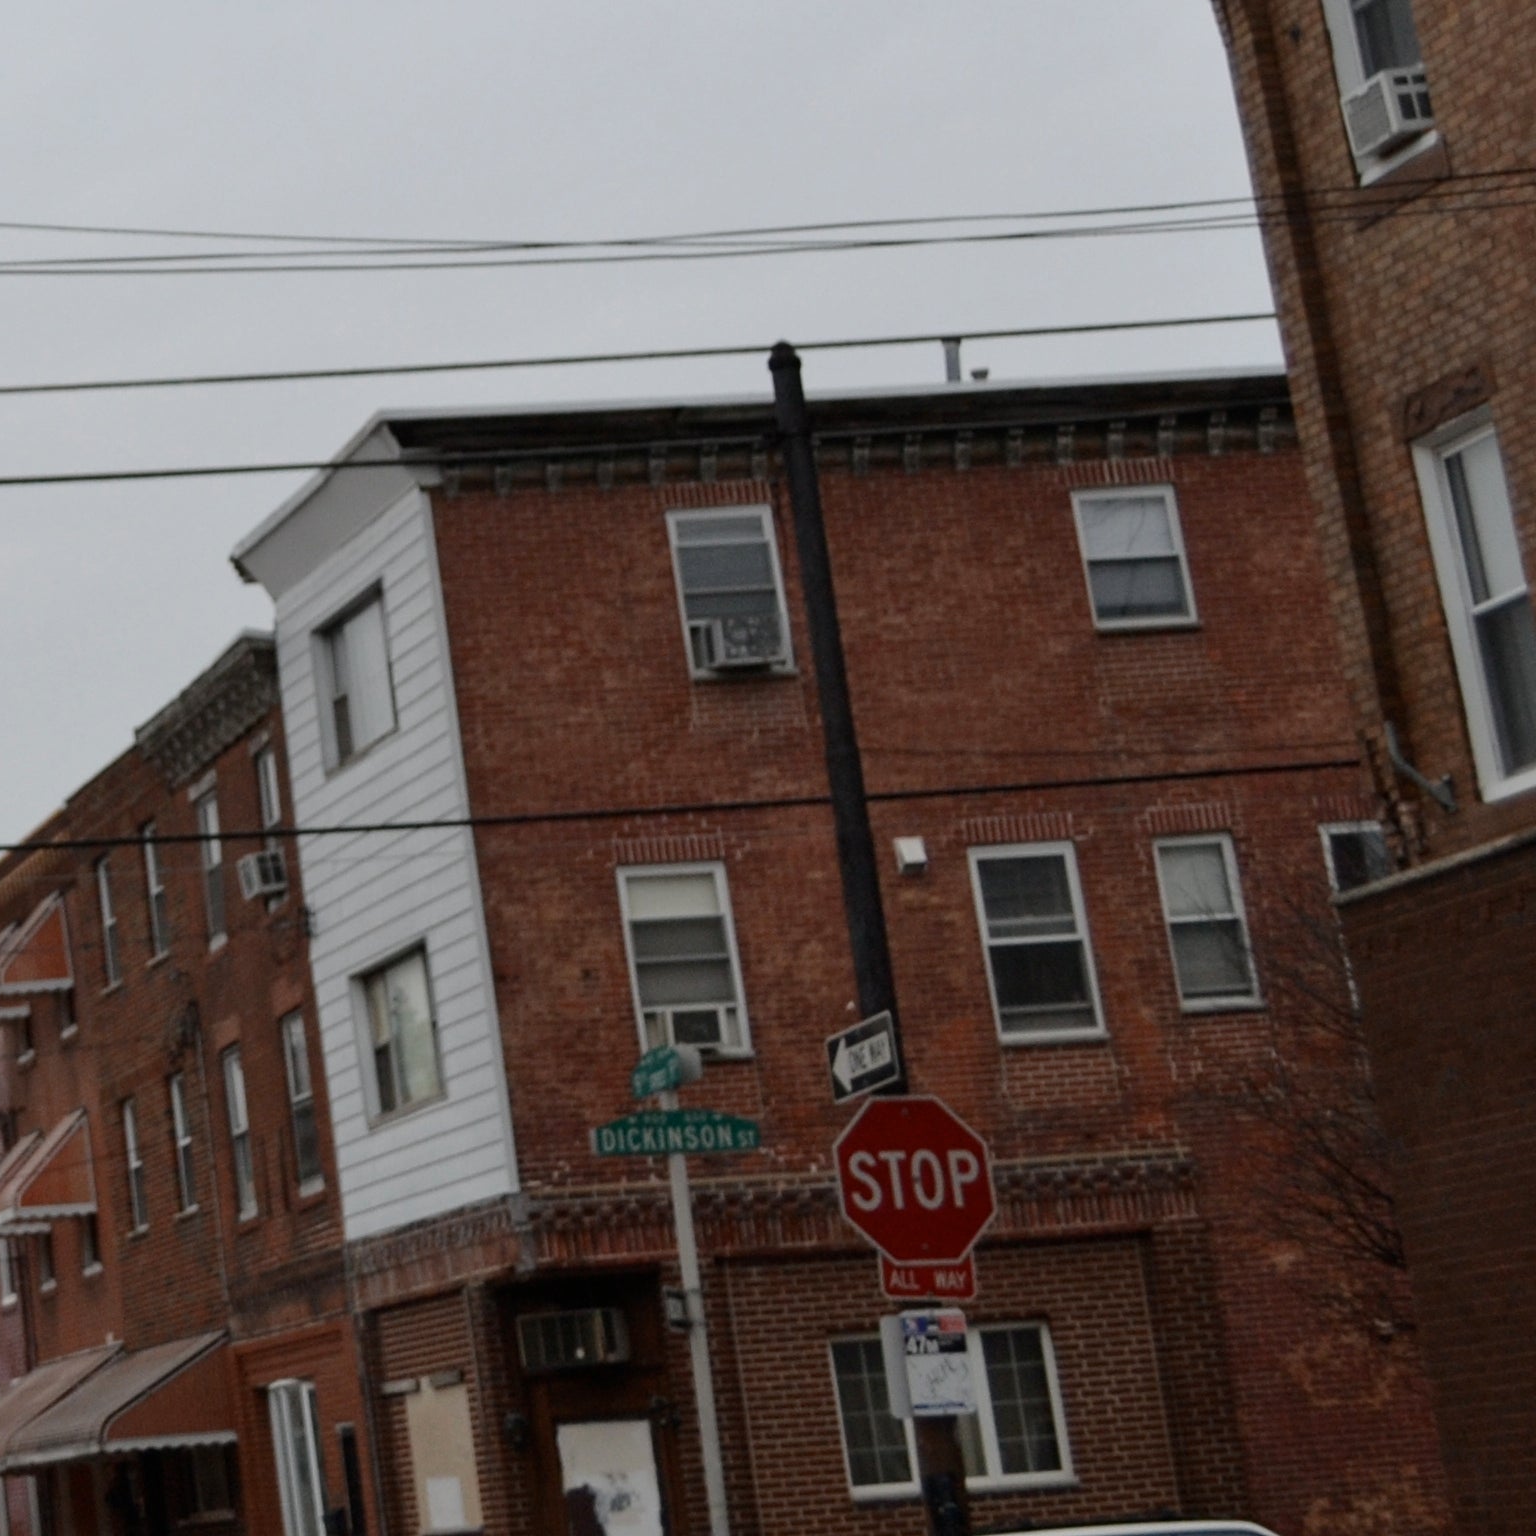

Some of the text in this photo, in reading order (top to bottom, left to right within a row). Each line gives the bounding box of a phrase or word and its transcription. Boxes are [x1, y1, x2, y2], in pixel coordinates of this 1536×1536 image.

[848, 1037, 887, 1074] ONE WAY
[601, 1124, 756, 1153] DICKINSON ST
[848, 1148, 980, 1212] STOP
[888, 1269, 967, 1291] ALL WAY
